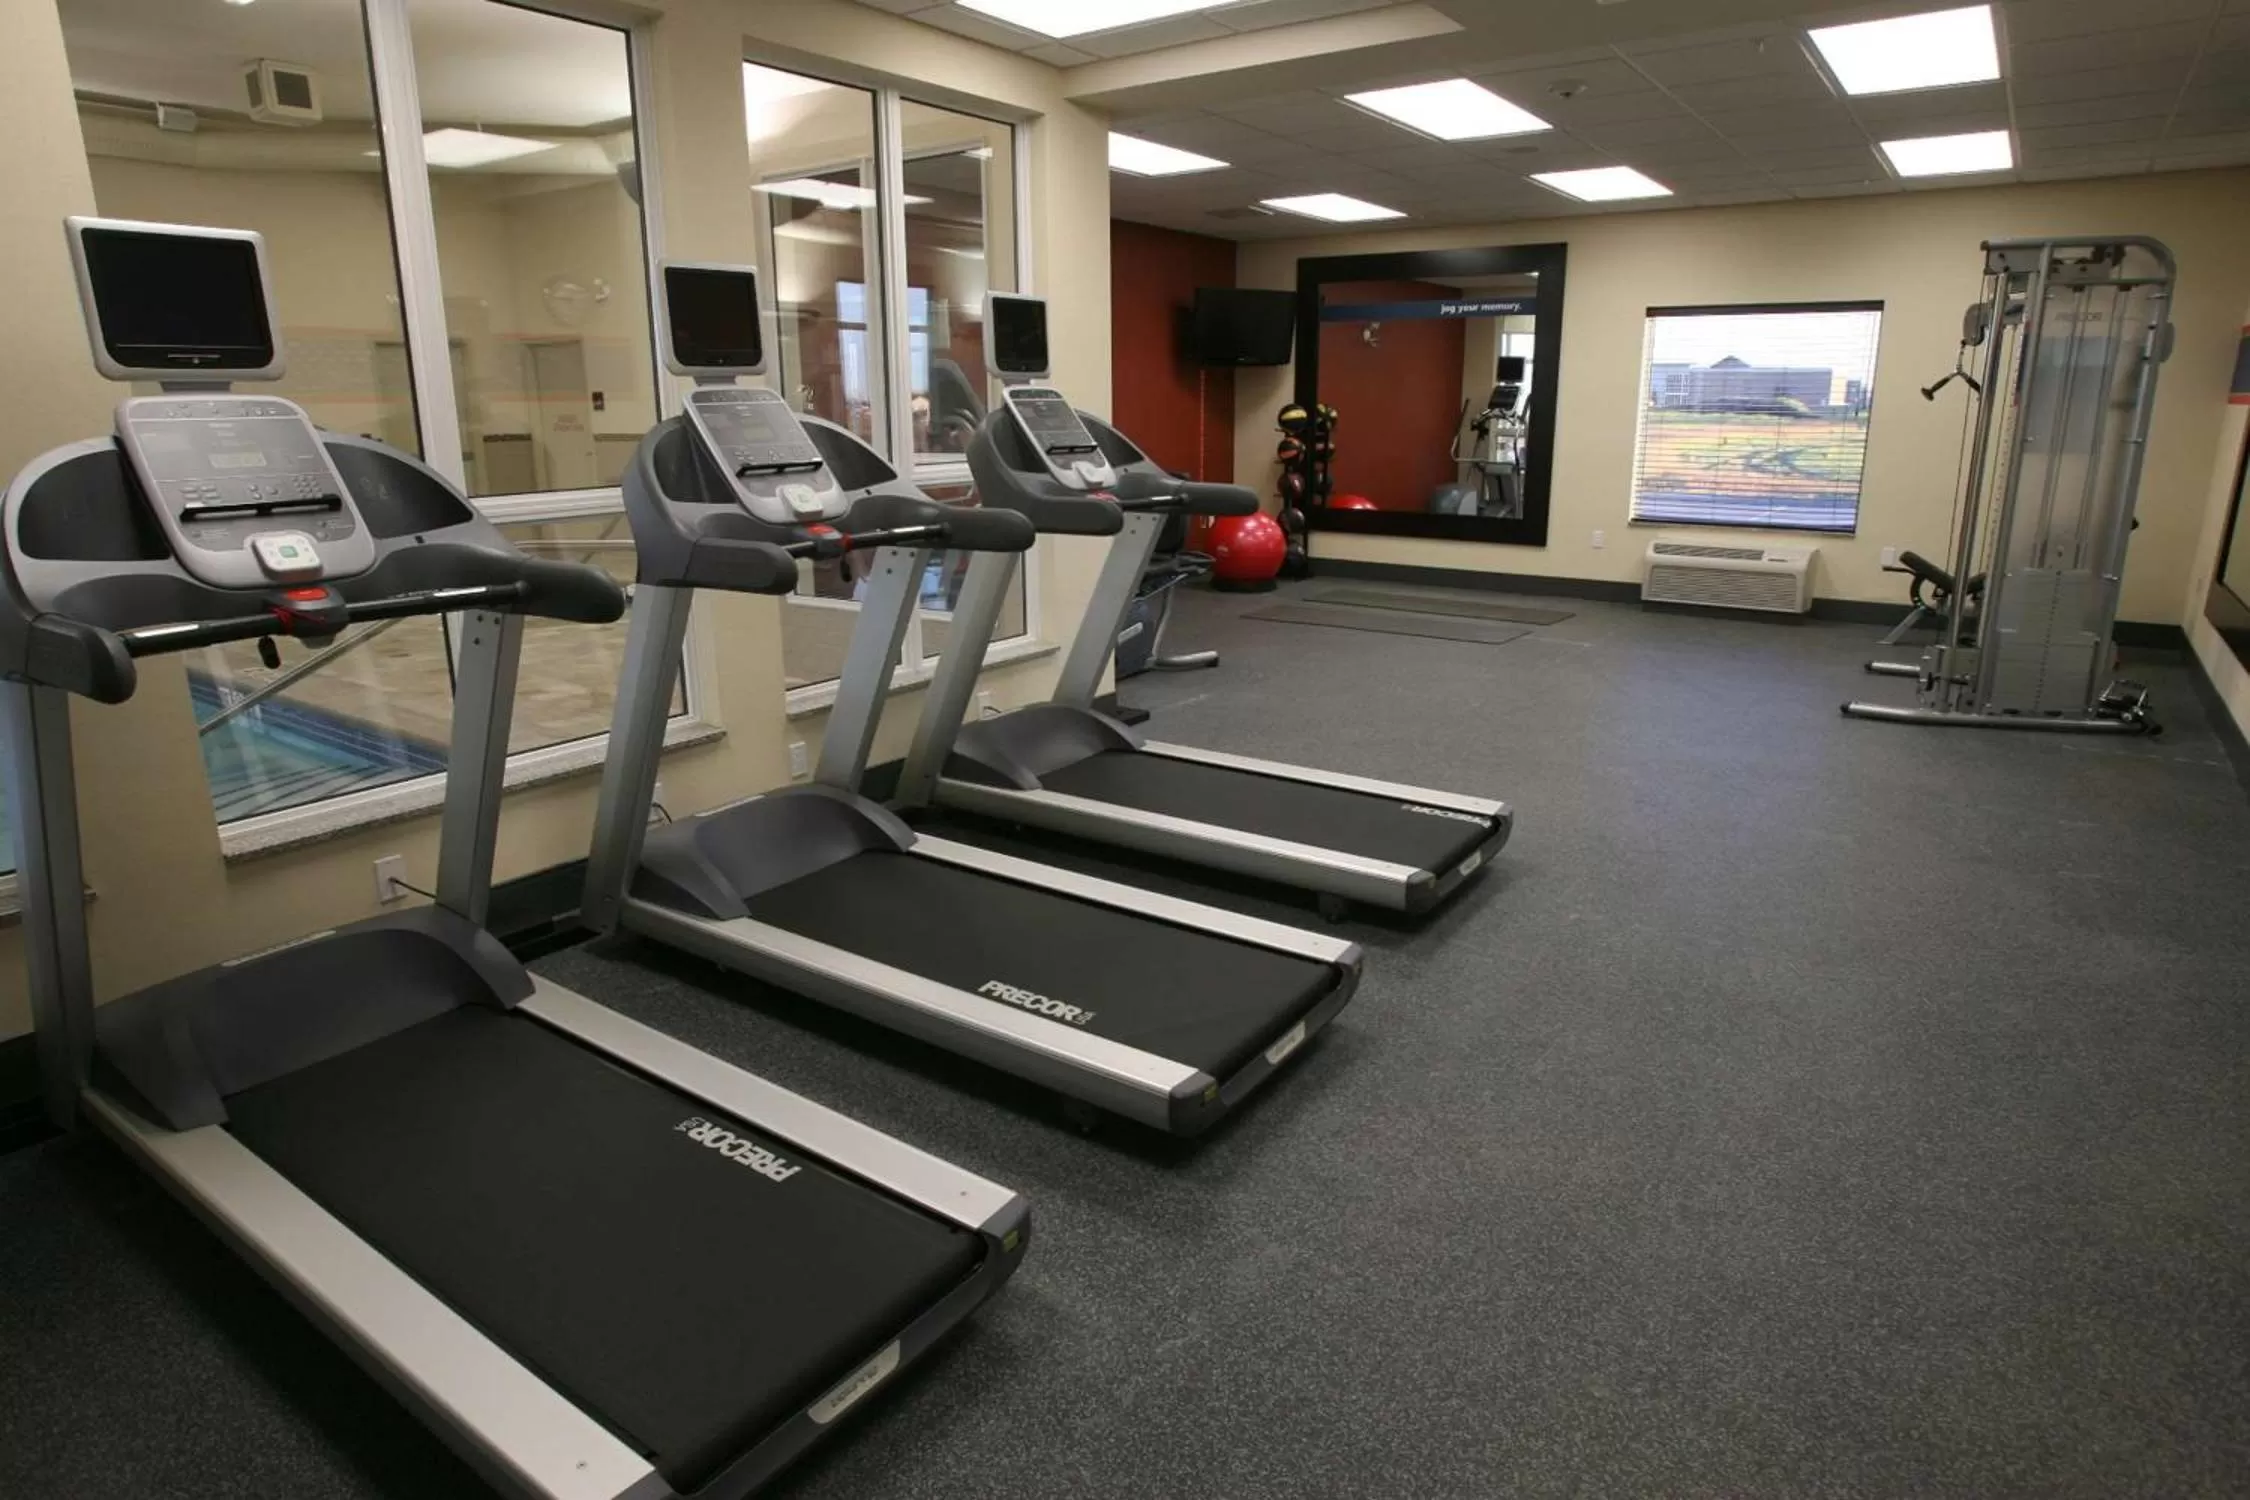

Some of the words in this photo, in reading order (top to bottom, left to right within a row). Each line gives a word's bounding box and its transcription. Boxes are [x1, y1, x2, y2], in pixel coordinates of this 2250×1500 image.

[1440, 303, 1456, 314] jog
[1458, 304, 1480, 313] your
[1481, 302, 1522, 312] memory.
[977, 980, 1083, 1021] PRECOR
[686, 1121, 803, 1182] PRECOR
